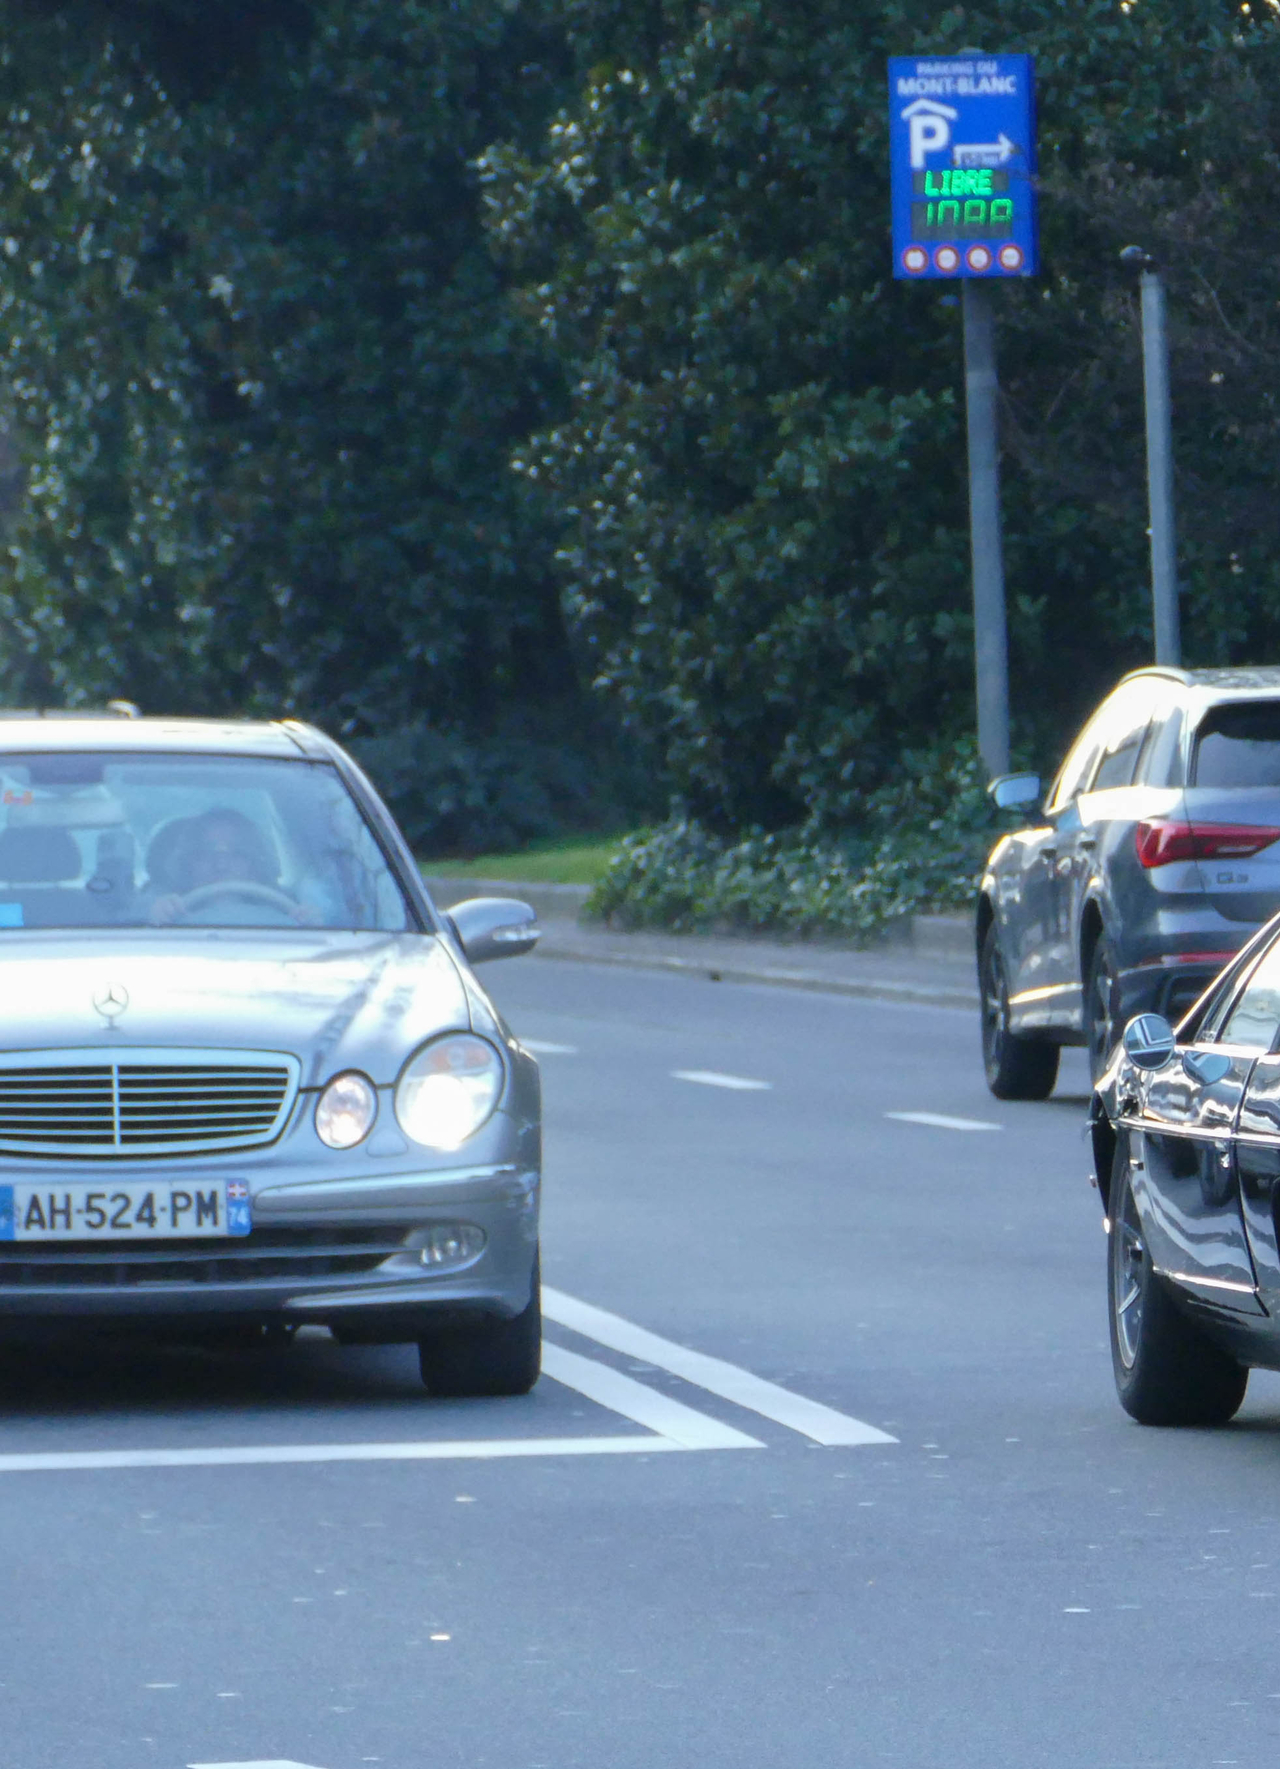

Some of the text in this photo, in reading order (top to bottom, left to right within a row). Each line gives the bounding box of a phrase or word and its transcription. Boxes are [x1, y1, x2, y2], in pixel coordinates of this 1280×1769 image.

[917, 60, 998, 75] PARKING DU
[897, 74, 1018, 95] MONT-BLANC
[909, 114, 950, 169] P
[924, 168, 993, 197] LIBRE
[24, 1190, 219, 1230] AH-524-PM
